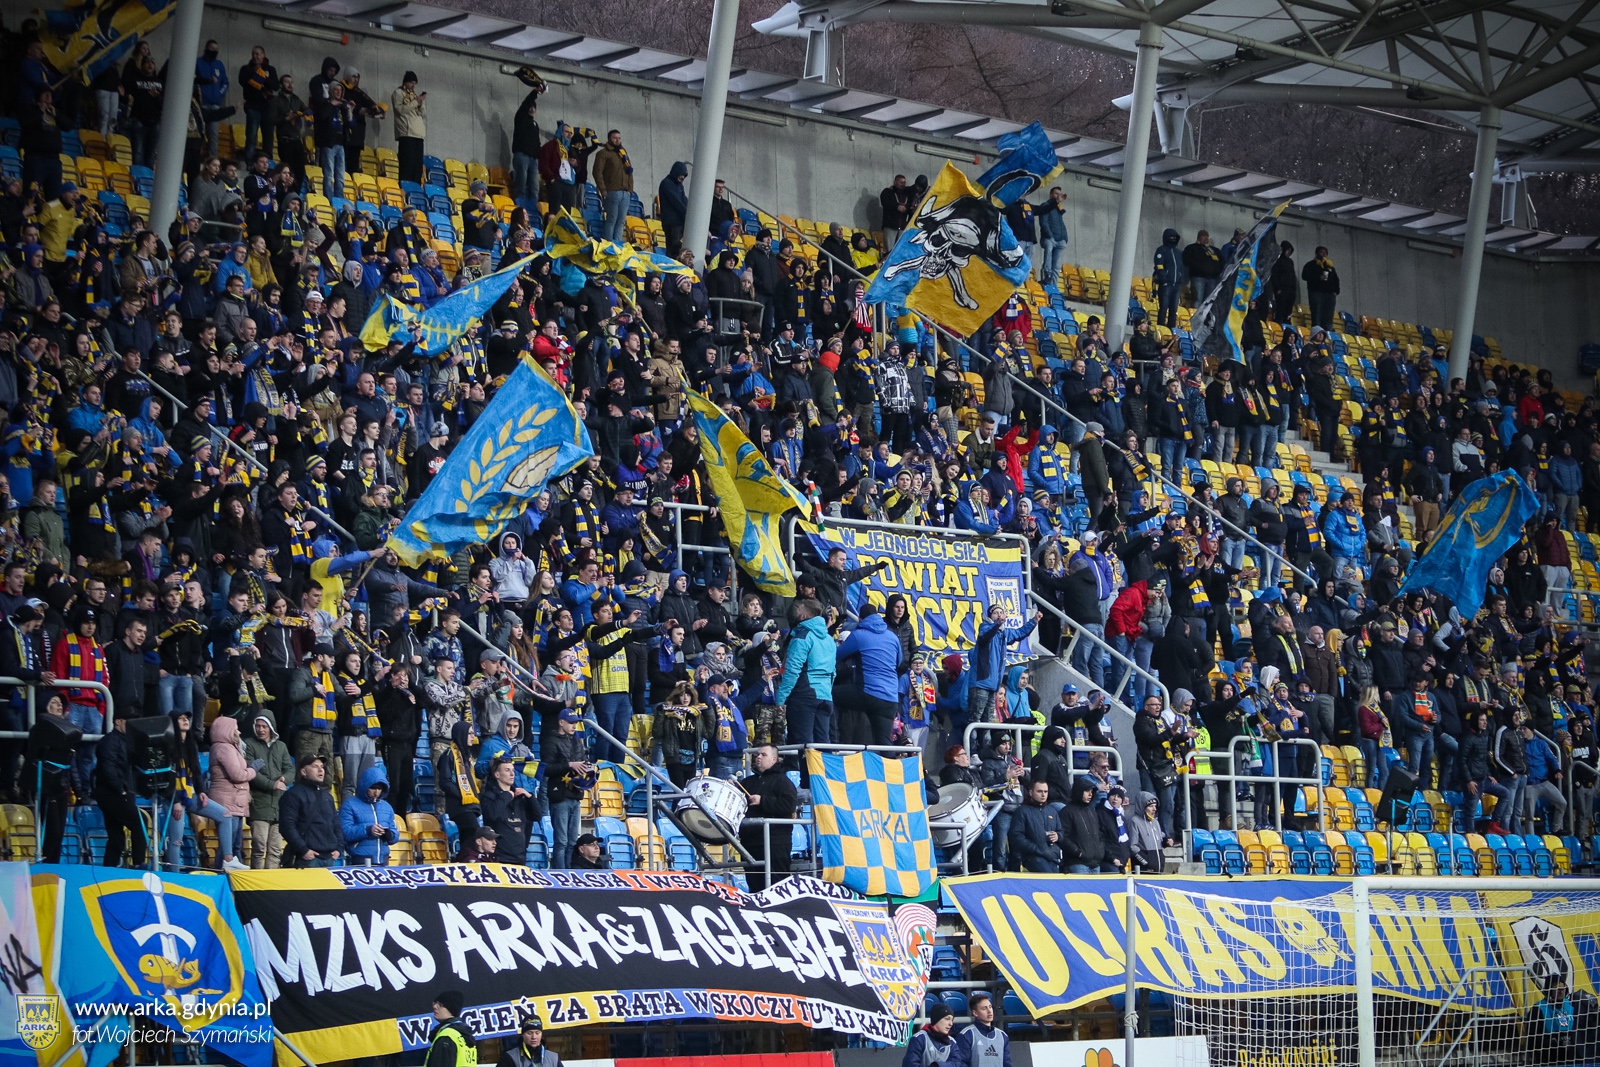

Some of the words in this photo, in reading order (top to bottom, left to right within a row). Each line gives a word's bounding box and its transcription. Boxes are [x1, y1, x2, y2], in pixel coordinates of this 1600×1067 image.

[837, 527, 857, 548] W
[863, 530, 949, 559] JEDNOŚCI
[952, 541, 990, 564] SIŁA
[856, 553, 979, 598] POWIAT
[860, 809, 912, 843] ARKA
[333, 864, 501, 888] POŁĄCZYŁA
[502, 866, 553, 887] NAS
[244, 908, 436, 1001] MZKS
[981, 890, 1287, 996] ULTRAS
[1331, 894, 1493, 999] ARKA
[869, 966, 911, 981] ARKA
[397, 1016, 432, 1046] W
[459, 996, 537, 1036] GIEŃ
[546, 997, 589, 1025] ZA
[593, 990, 684, 1019] BRATA
[683, 989, 797, 1019] WSKOCZY
